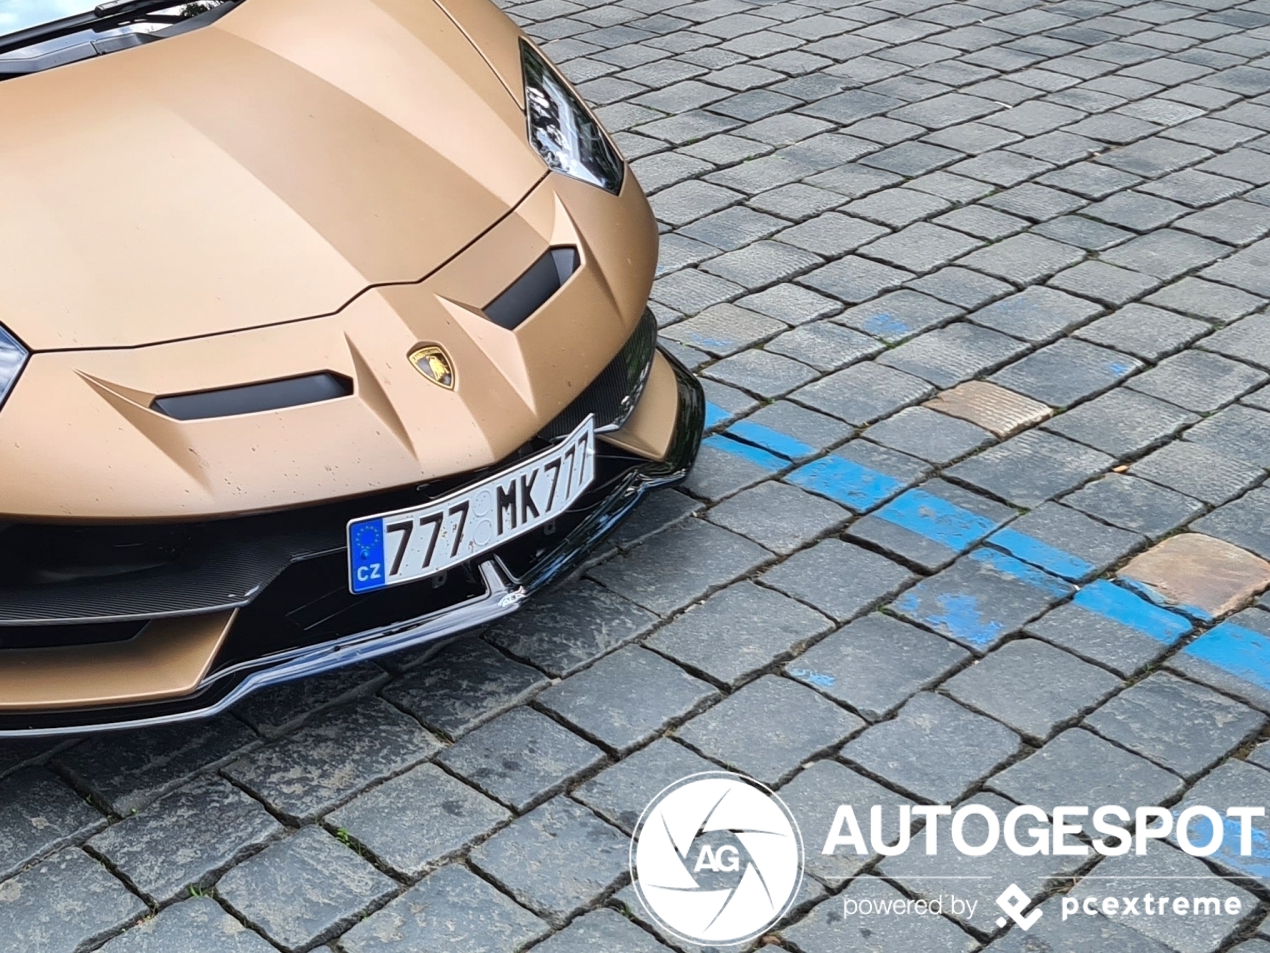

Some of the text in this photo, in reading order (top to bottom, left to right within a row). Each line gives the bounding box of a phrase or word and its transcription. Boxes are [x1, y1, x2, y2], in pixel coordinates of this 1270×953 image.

[357, 430, 589, 582] CZ 777 MK777
